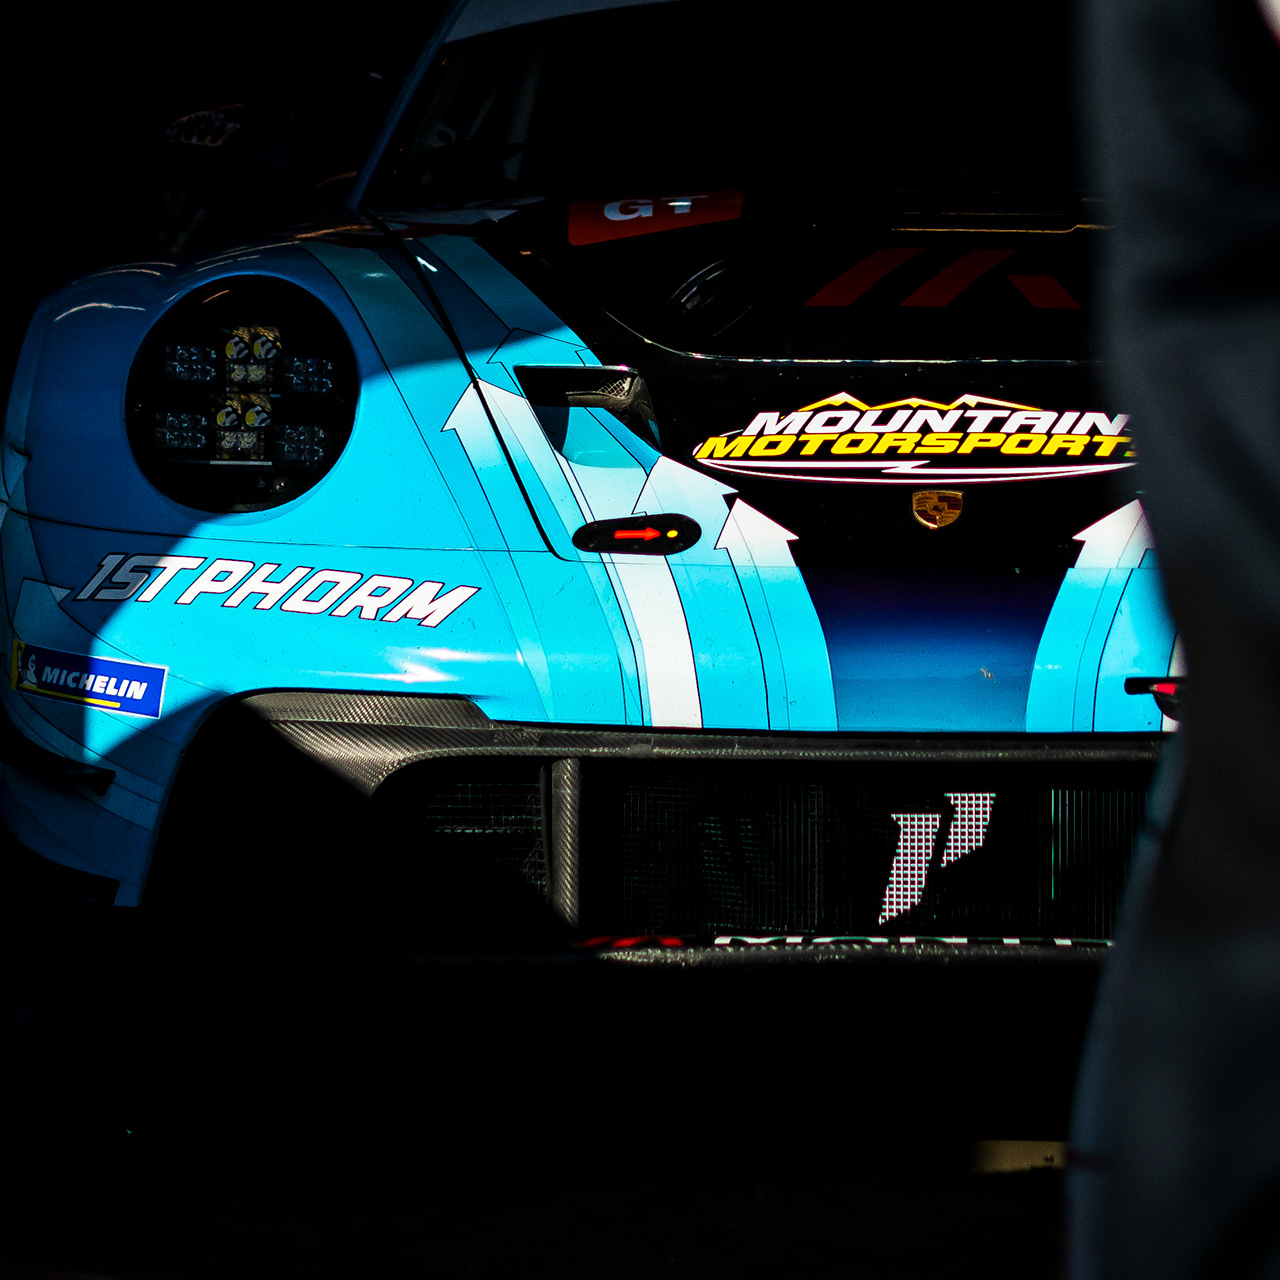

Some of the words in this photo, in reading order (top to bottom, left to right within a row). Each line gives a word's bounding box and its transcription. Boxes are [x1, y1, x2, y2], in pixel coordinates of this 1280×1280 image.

[603, 194, 710, 221] GT
[740, 408, 1131, 437] MOUNTAIN
[41, 665, 148, 700] MICHELIN
